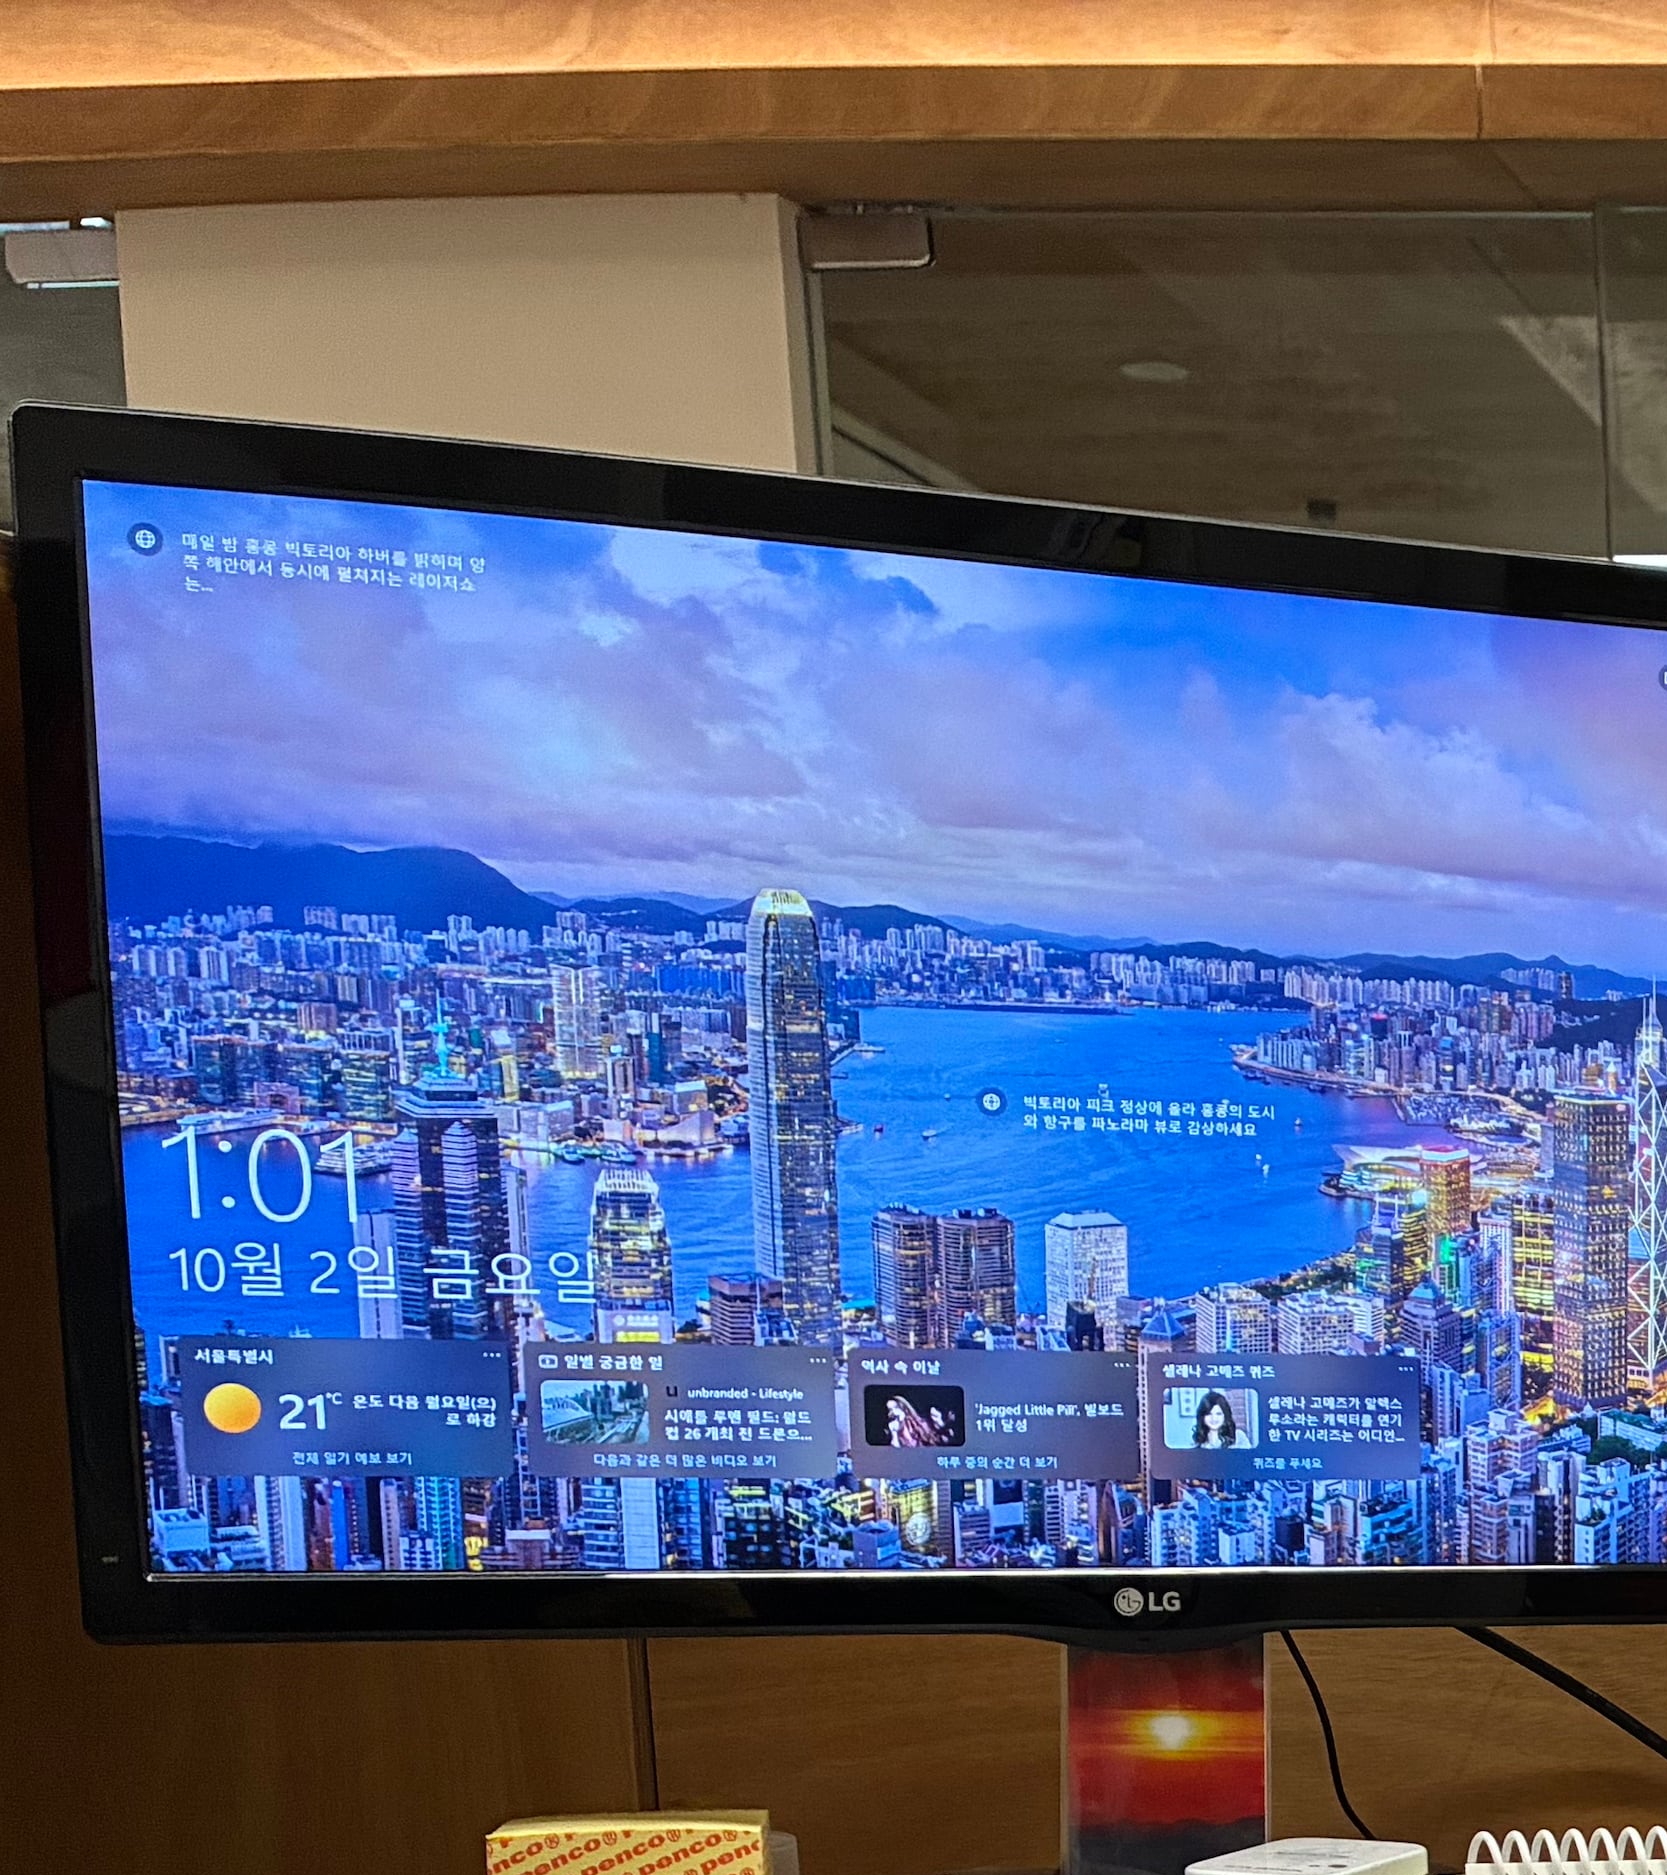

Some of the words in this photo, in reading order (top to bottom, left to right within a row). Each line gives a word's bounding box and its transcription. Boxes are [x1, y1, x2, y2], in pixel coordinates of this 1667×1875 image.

[182, 533, 215, 552] 매일
[221, 536, 237, 553] 밤
[245, 537, 279, 555] 홍콩
[285, 540, 351, 562] 빅토리아
[358, 546, 407, 568] 하버를
[414, 550, 463, 571] 밝히며
[470, 555, 486, 574] 양
[206, 555, 273, 577] 해안에서
[280, 561, 330, 582] 동시에
[336, 564, 402, 588] 펼쳐지는
[409, 570, 476, 592] 레이저쇼
[1023, 1095, 1081, 1112] 빅토리아
[1086, 1097, 1115, 1113] 피크
[1120, 1099, 1163, 1116] 정상에
[1168, 1101, 1196, 1117] 올라
[1201, 1102, 1243, 1119] 홍콩의
[1248, 1104, 1276, 1121] 도시
[1023, 1113, 1038, 1129] 와
[1043, 1115, 1086, 1131] 항구를
[1091, 1116, 1149, 1134] 파노라마
[1154, 1118, 1182, 1134] 뷰로
[1187, 1119, 1257, 1137] 감상하세요
[161, 1127, 362, 1226] 1:01
[168, 1243, 286, 1297] 10월
[309, 1245, 398, 1301] 2일
[423, 1246, 598, 1305] 금요일
[194, 1349, 274, 1366] 서울특별시
[688, 1386, 748, 1399] unbranded
[759, 1387, 803, 1402] Lifestyle
[1148, 1591, 1181, 1612] LG
